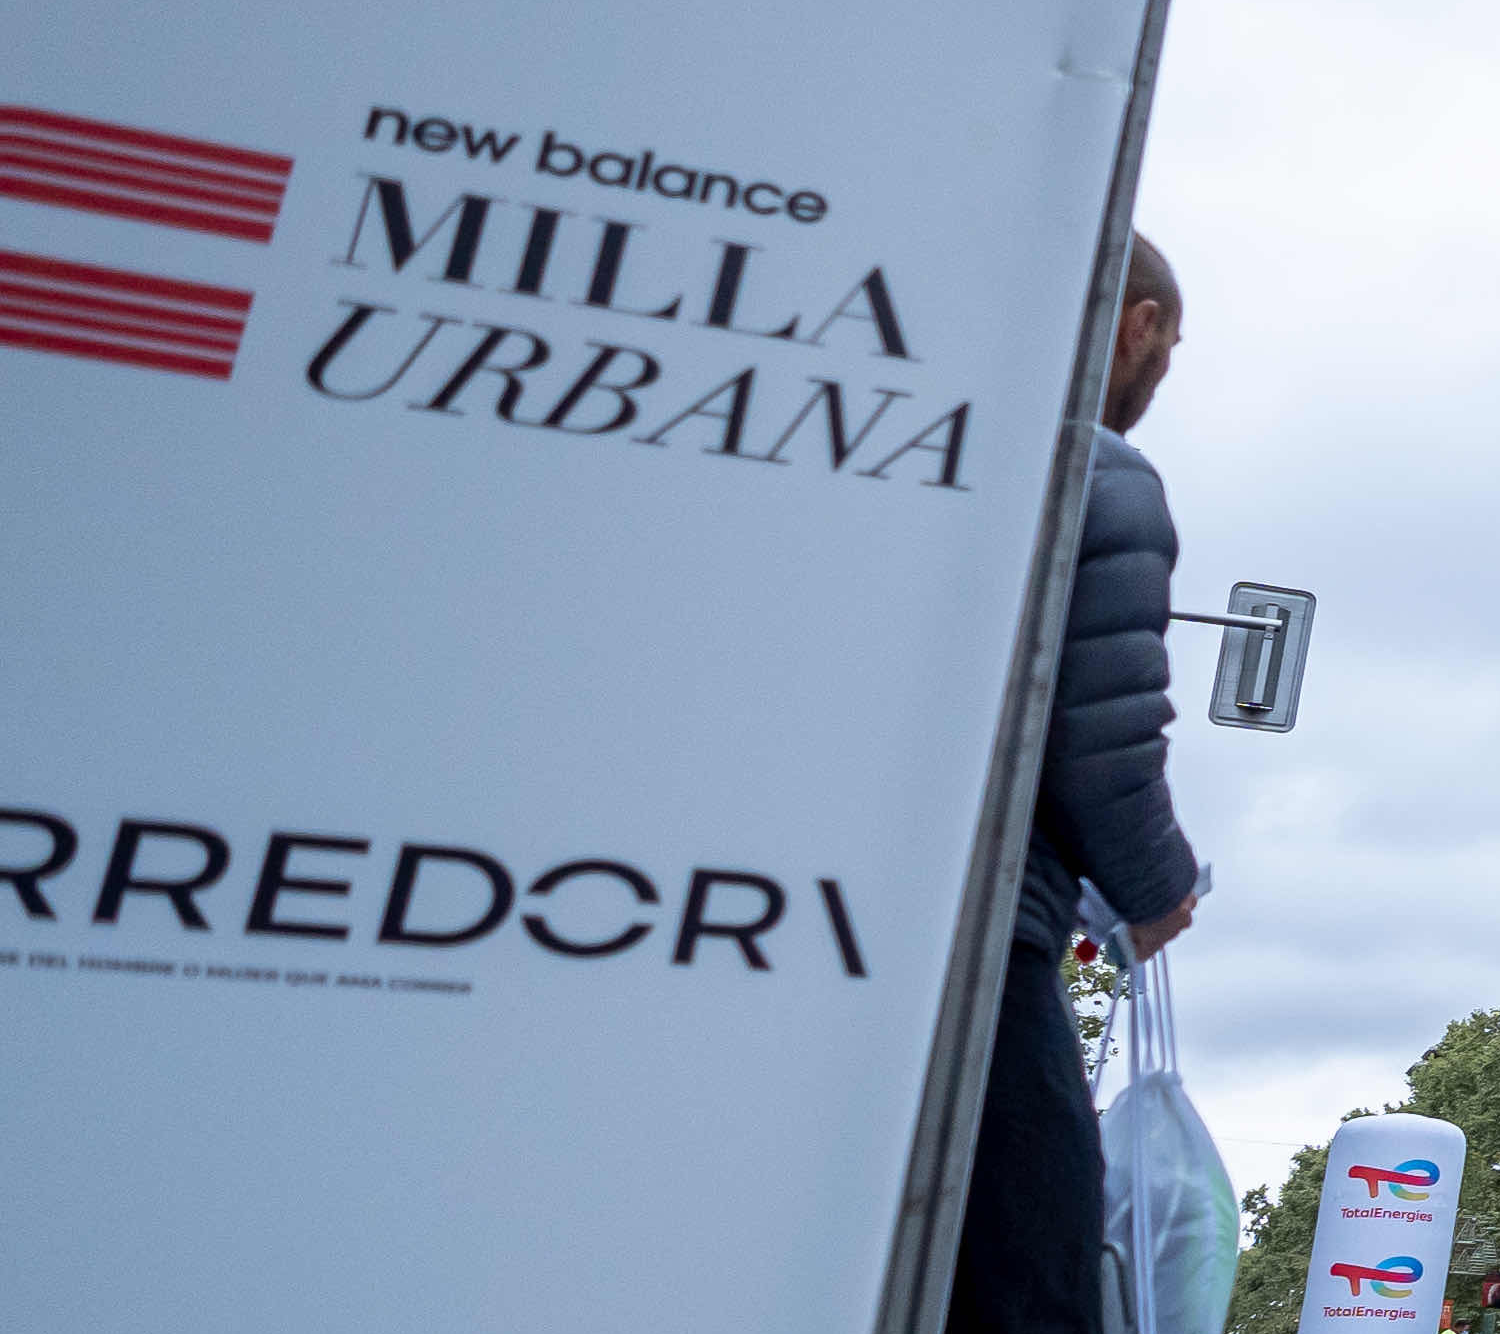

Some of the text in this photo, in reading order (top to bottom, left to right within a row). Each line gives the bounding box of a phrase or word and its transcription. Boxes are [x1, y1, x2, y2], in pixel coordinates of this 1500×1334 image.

[363, 106, 830, 225] new balance
[331, 172, 924, 364] MILLA
[304, 300, 975, 492] URBANA
[1340, 1207, 1434, 1223] TotalEnergies
[1323, 1306, 1417, 1321] TotalEnergies
